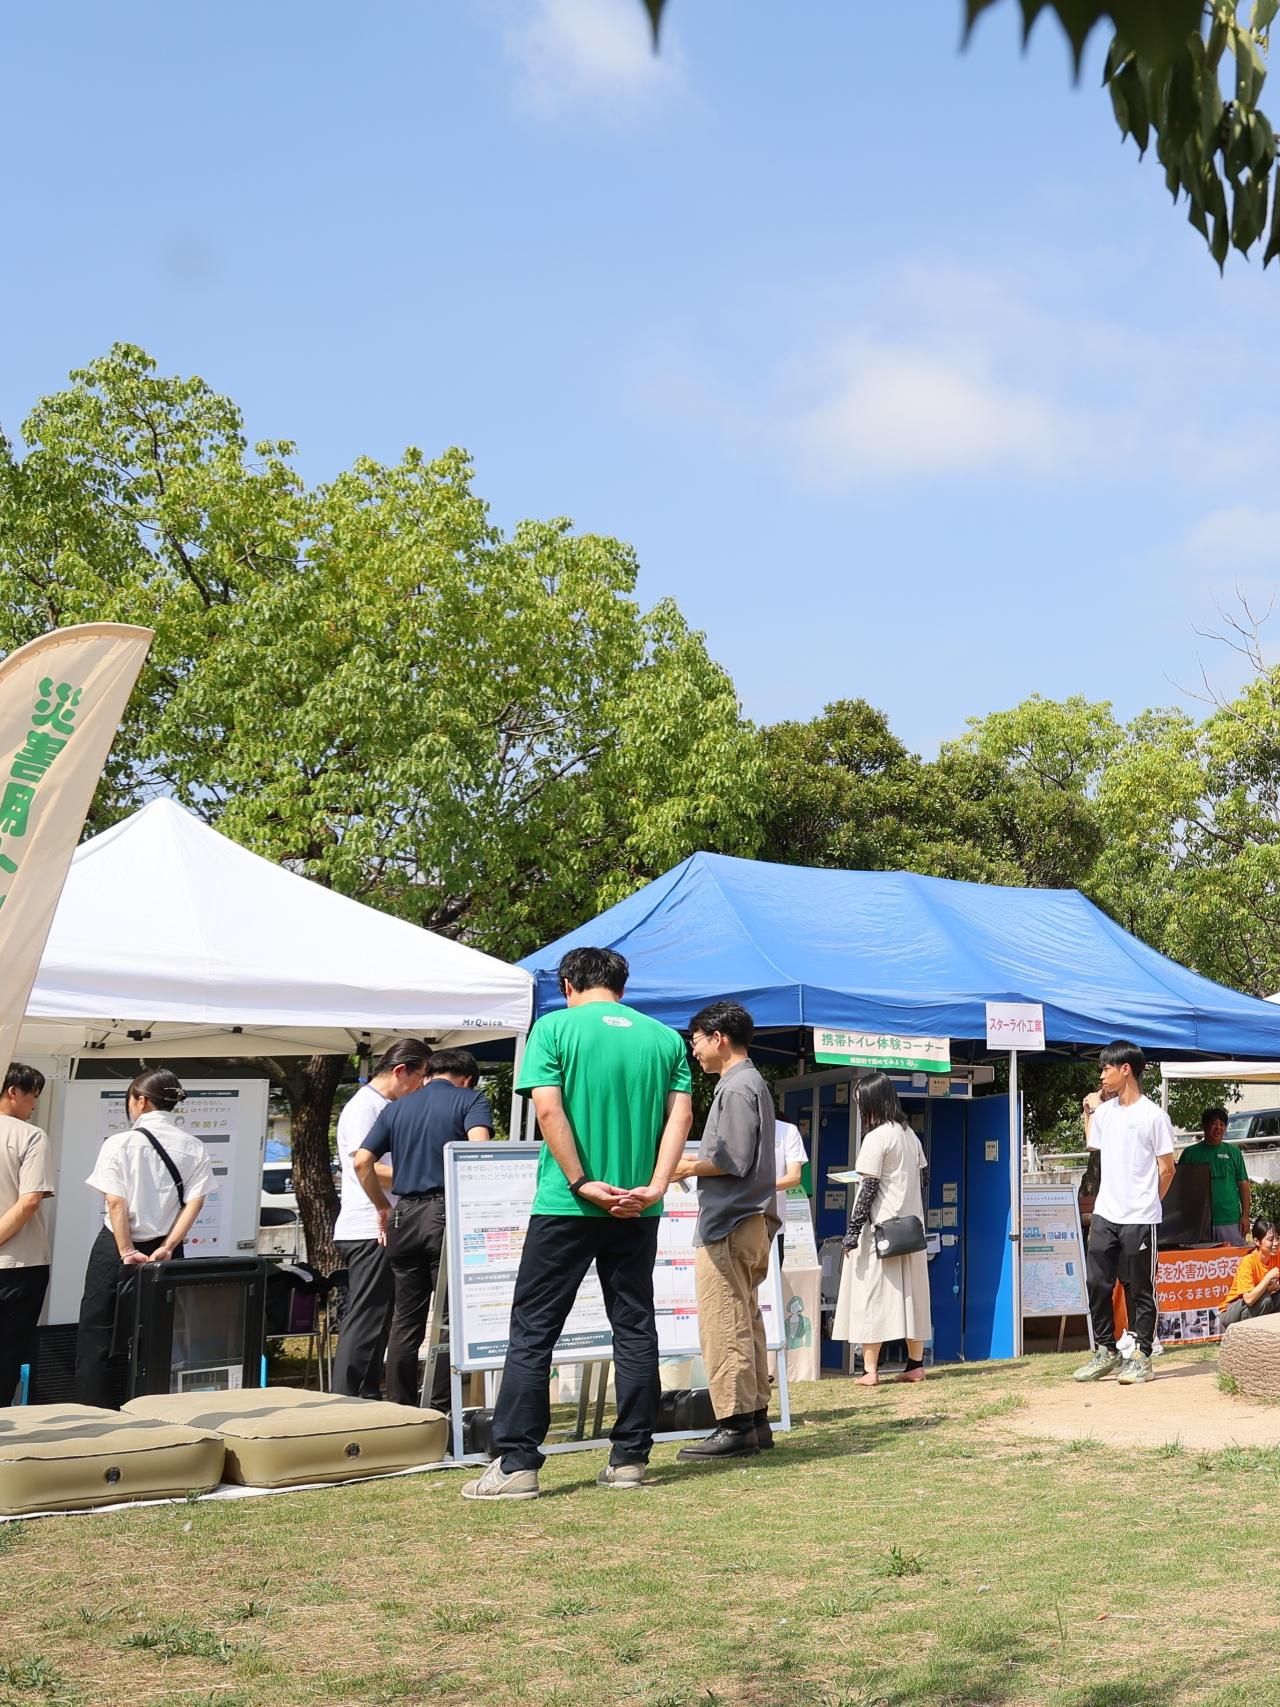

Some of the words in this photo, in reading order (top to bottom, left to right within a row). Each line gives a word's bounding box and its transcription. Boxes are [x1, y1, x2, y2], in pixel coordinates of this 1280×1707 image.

[0, 676, 83, 909] 災害用
[989, 1017, 1043, 1033] スターライト工業
[821, 1032, 945, 1052] 携帯トイレ体験コーナー
[1156, 1285, 1229, 1302] からくるまを守り
